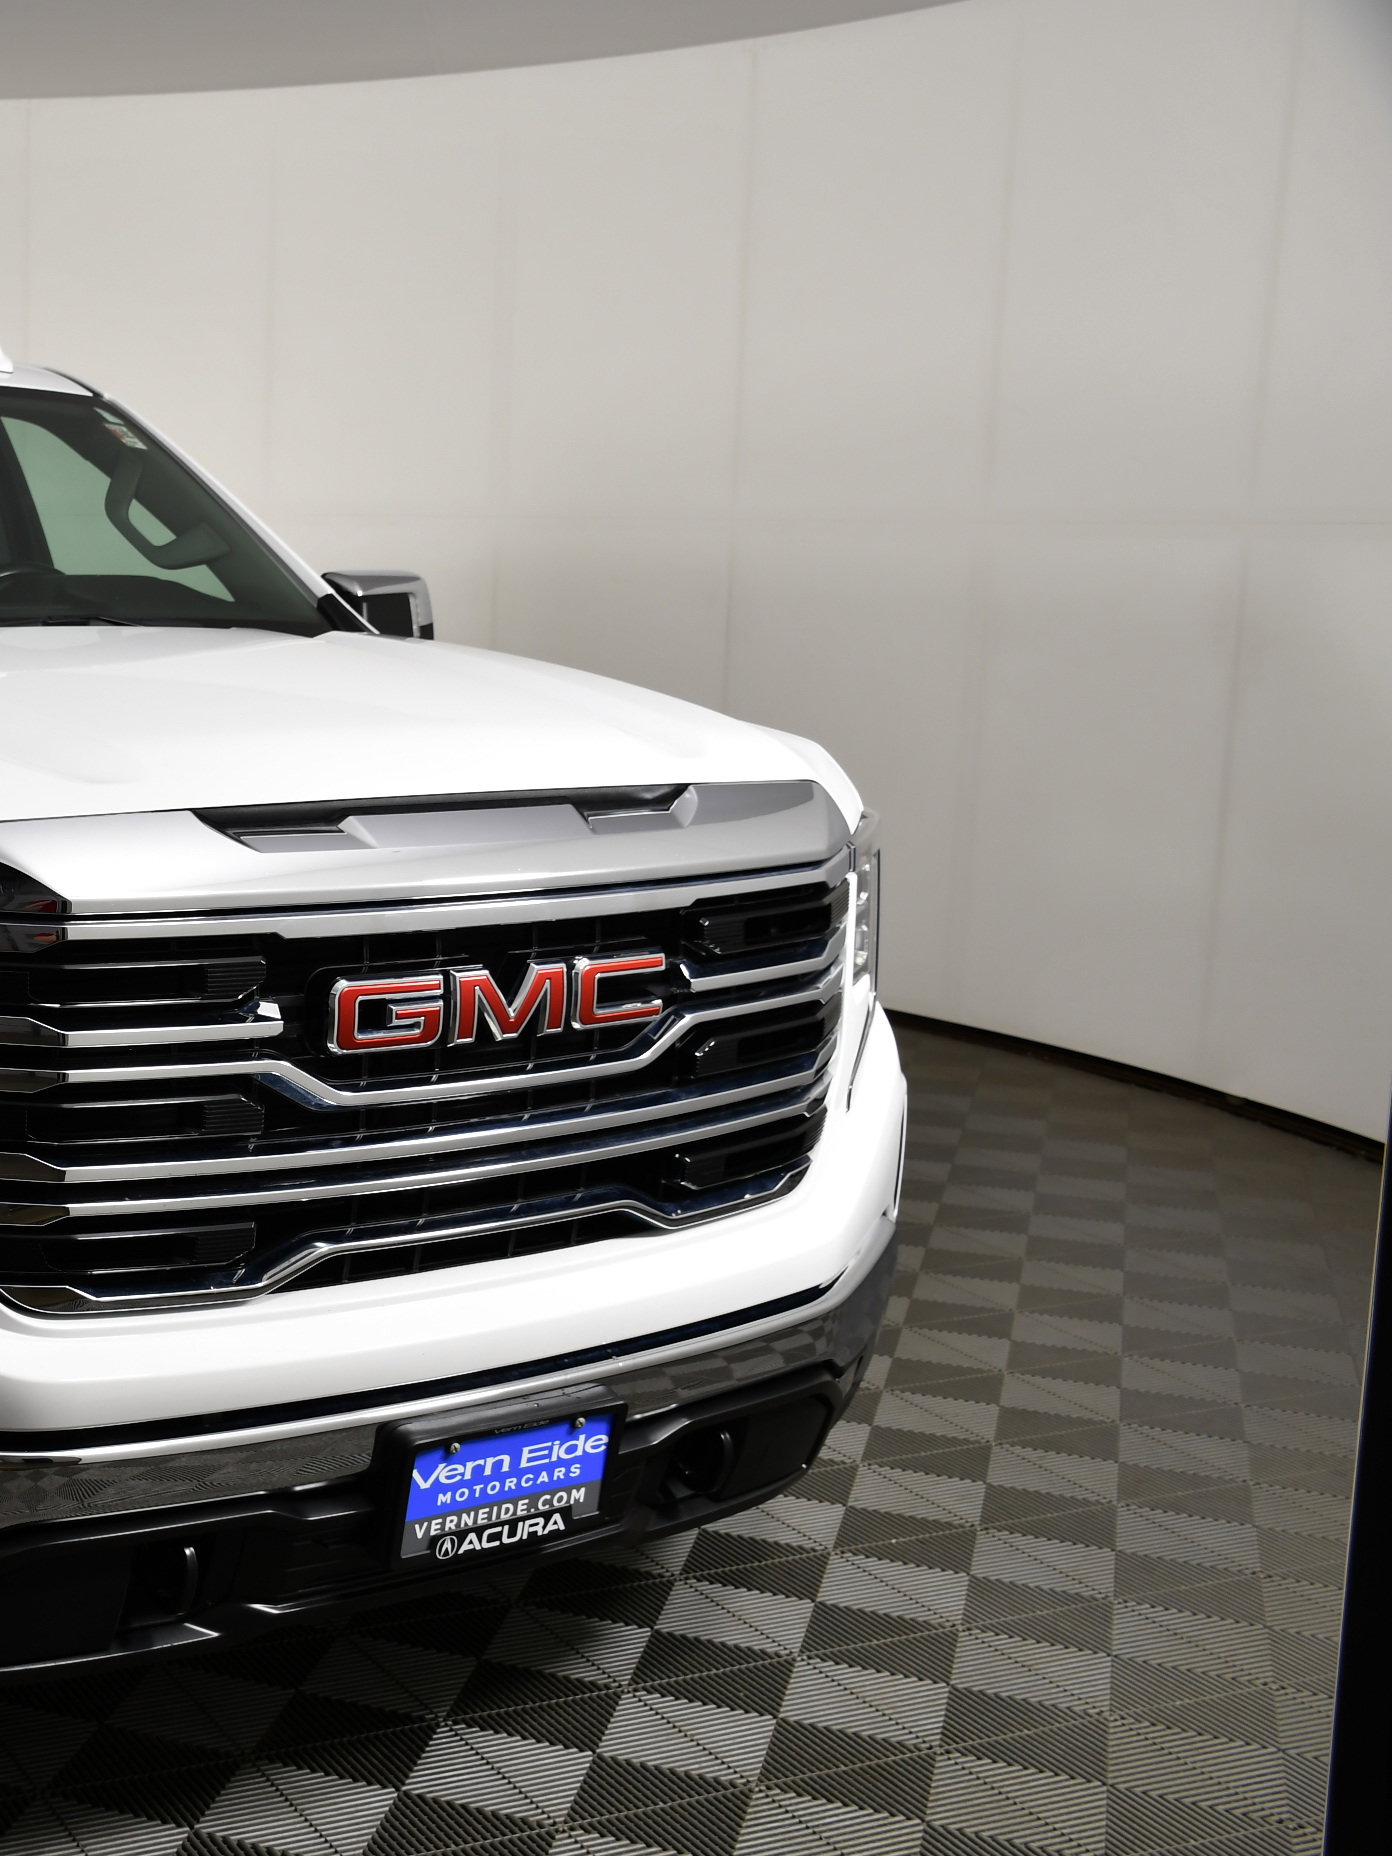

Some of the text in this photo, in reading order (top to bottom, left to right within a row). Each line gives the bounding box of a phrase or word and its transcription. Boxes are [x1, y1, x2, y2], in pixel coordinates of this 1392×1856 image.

[327, 953, 666, 1055] GMC
[412, 1434, 609, 1490] Vern Eide
[437, 1464, 581, 1506] MOTORCARS
[414, 1487, 586, 1539] VERNEIDE.COM
[457, 1512, 565, 1554] ACURA
